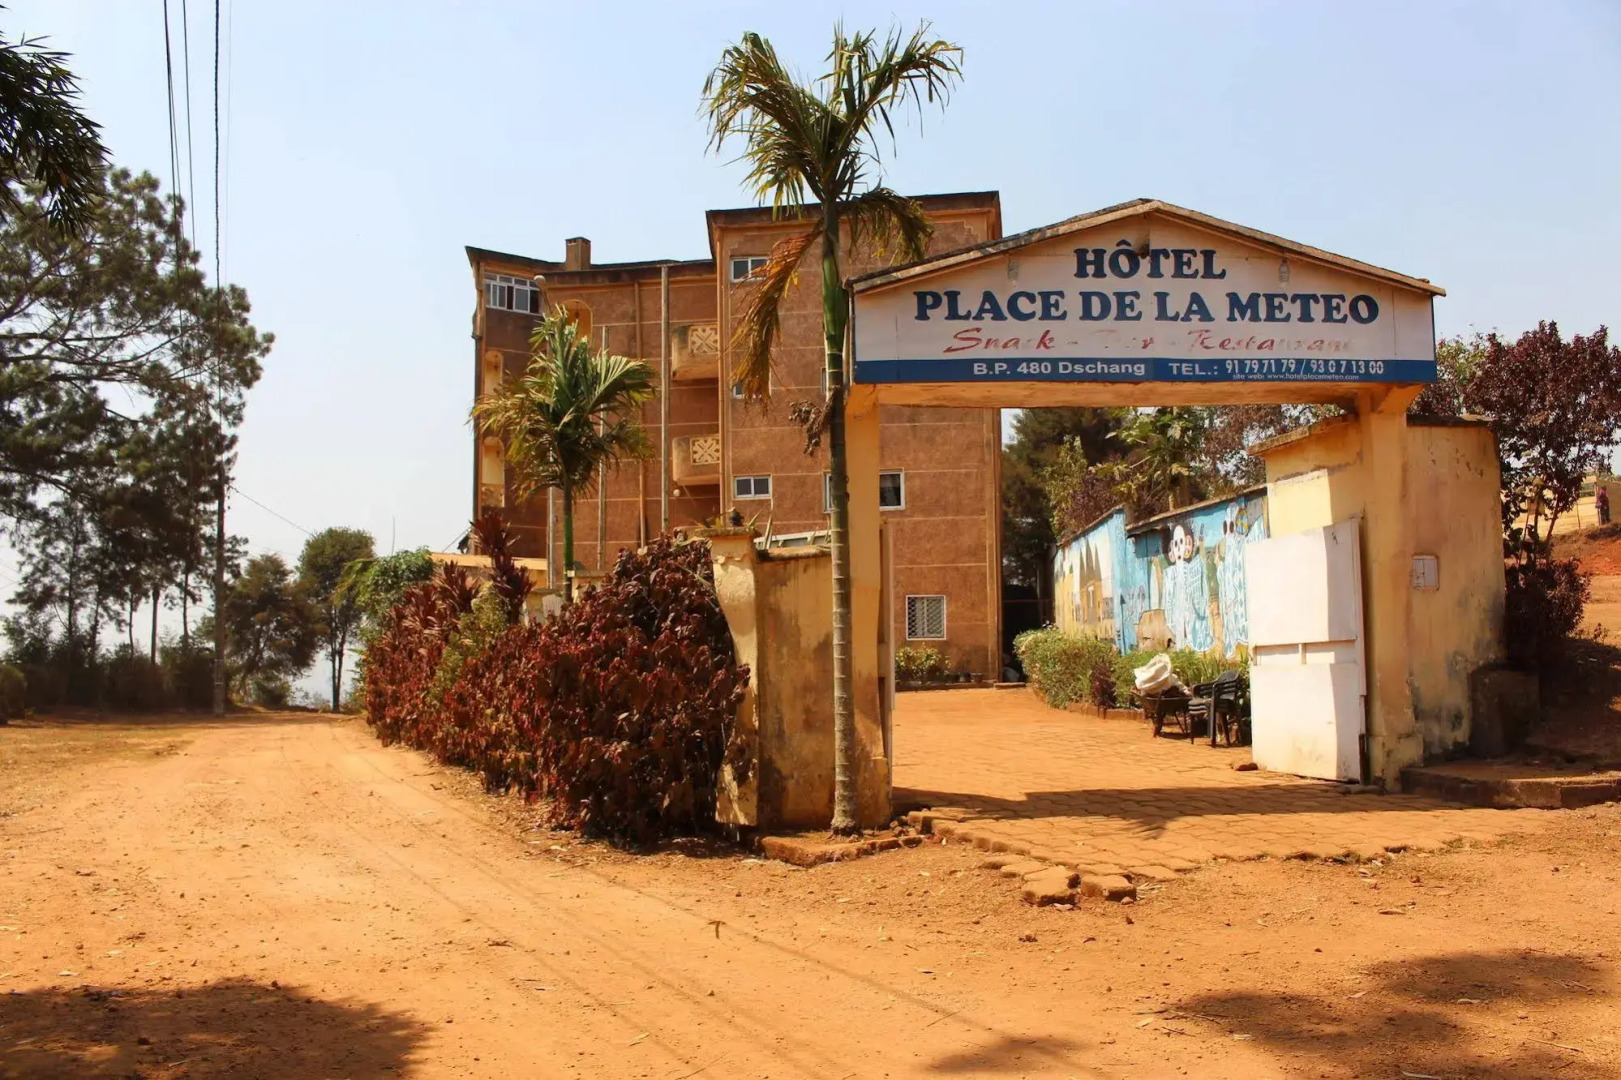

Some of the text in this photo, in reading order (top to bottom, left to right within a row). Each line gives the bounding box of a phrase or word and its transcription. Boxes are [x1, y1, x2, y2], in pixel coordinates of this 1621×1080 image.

[1073, 239, 1226, 279] HÔTEL
[913, 290, 1379, 324] PLACE DE LA METEO
[973, 361, 1145, 376] B.P. 480 Dschang
[1168, 362, 1218, 375] TEL.:
[1225, 360, 1239, 373] 91
[1244, 360, 1258, 373] 79
[1262, 359, 1276, 373] 71
[1281, 359, 1296, 373] 79
[1310, 360, 1325, 373] 93
[1351, 361, 1365, 374] 13
[1369, 361, 1384, 374] 00
